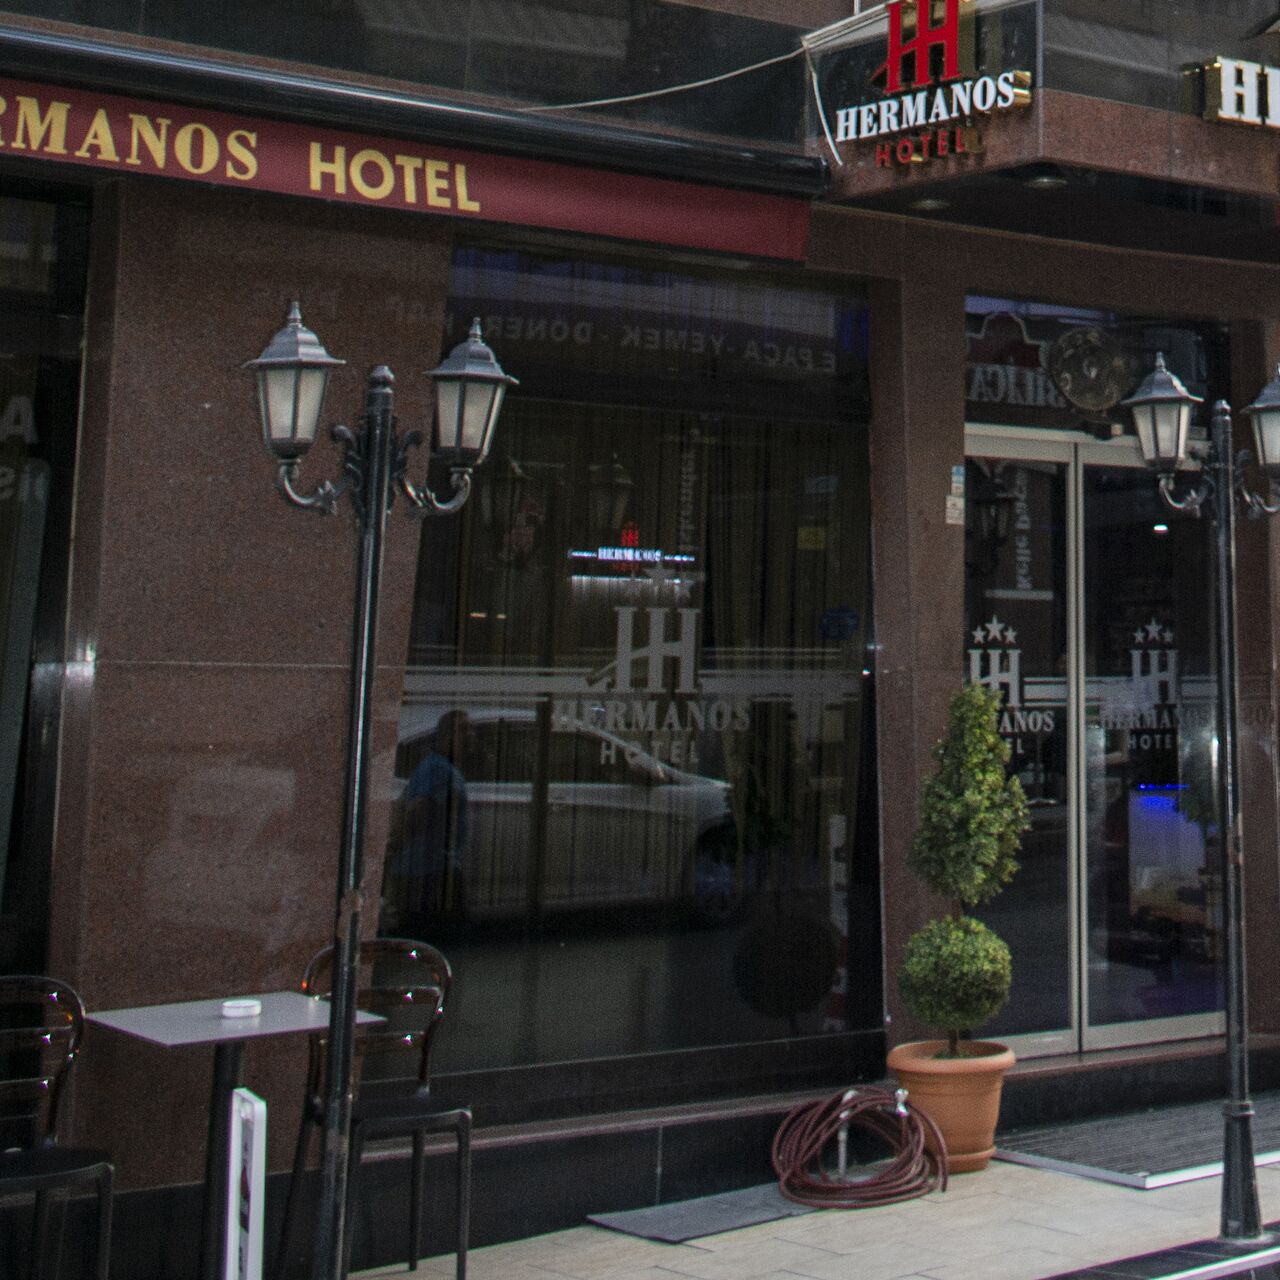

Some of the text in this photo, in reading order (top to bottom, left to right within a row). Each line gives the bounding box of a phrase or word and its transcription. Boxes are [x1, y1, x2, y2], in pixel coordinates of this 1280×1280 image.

[836, 72, 1016, 142] HERMANOS
[0, 95, 480, 212] MANOS HOTEL
[876, 127, 966, 167] HOTEL
[551, 700, 750, 732] HERMANOS
[1130, 734, 1173, 750] HOTE
